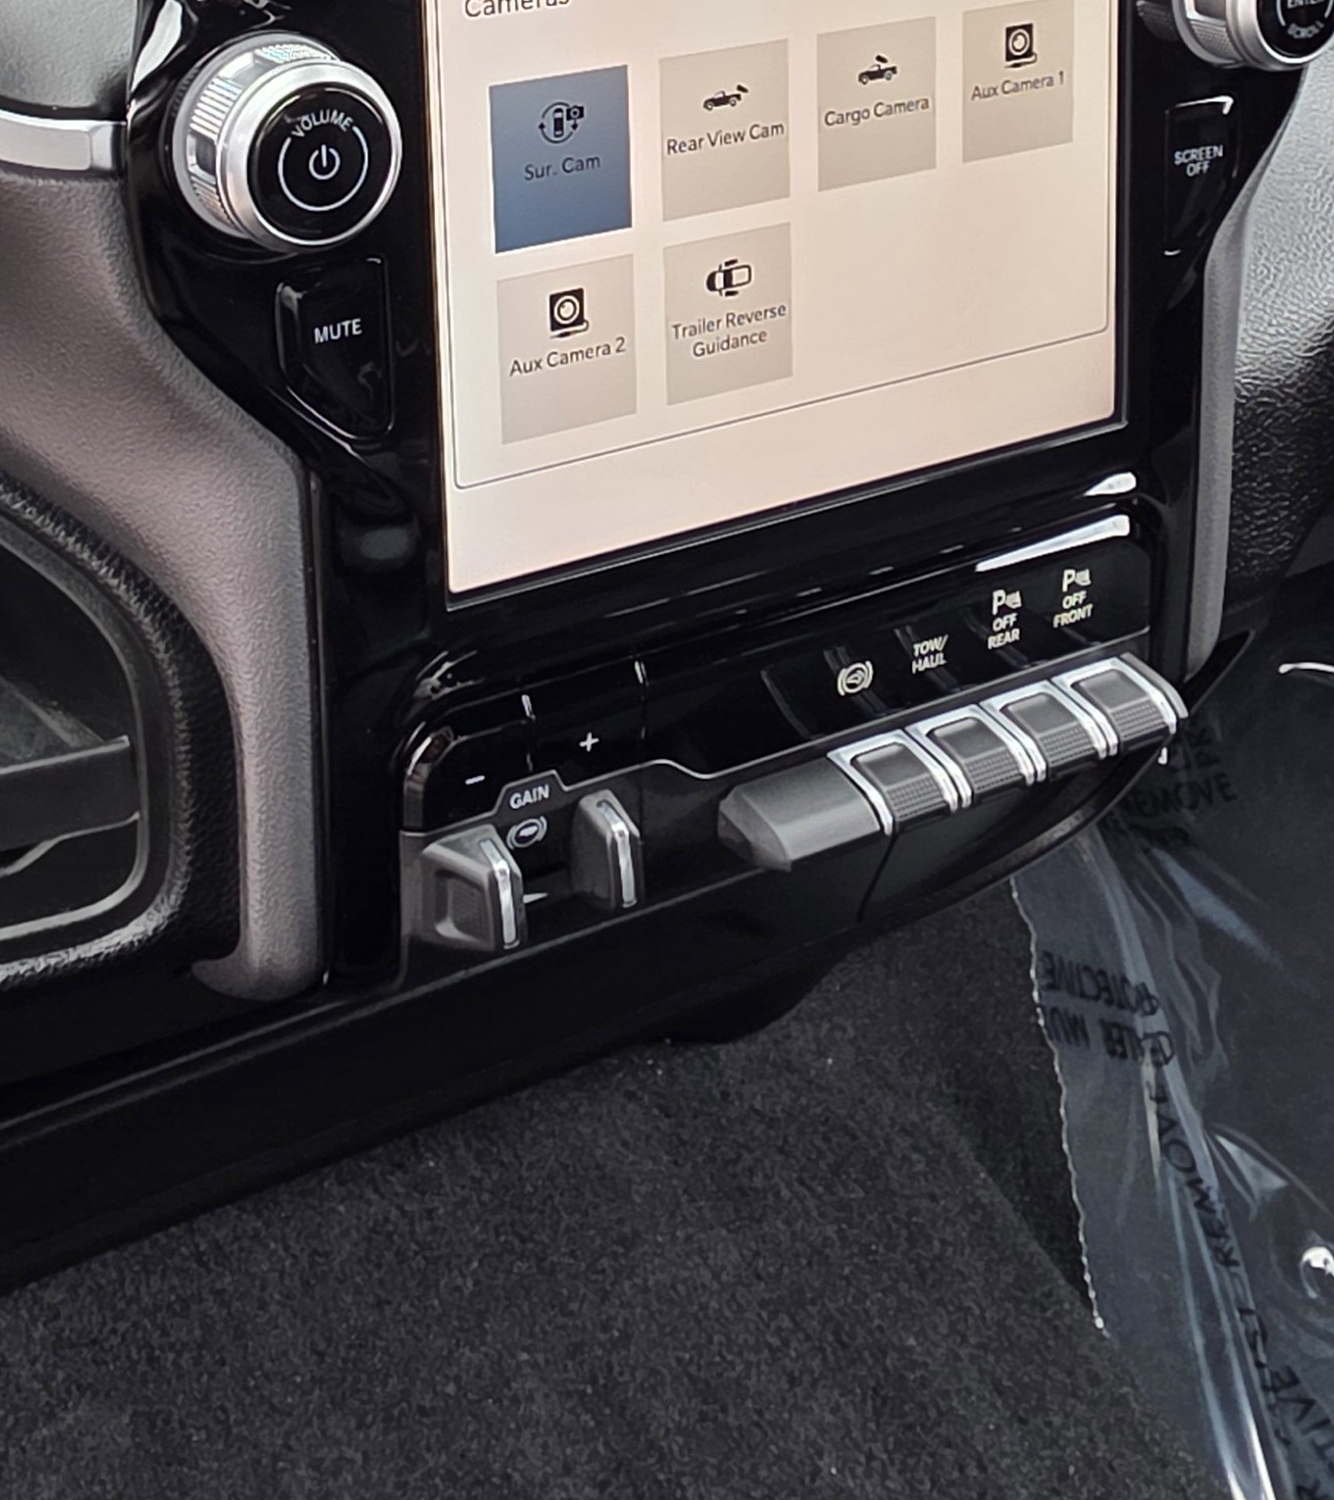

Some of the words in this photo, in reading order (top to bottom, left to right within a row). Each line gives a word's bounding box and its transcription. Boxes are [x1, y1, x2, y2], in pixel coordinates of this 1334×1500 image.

[970, 86, 999, 102] Aux
[1001, 75, 1054, 95] Camera
[1057, 70, 1065, 86] 1
[291, 109, 354, 137] VOLUME
[823, 108, 870, 126] Cargo
[873, 97, 930, 118] Camera
[667, 138, 704, 155] Rear
[707, 129, 746, 147] View
[749, 123, 784, 140] Cam
[1173, 145, 1224, 165] SCREEN
[524, 163, 558, 181] Sur.
[562, 156, 601, 174] Cam
[1186, 160, 1211, 177] OFF
[313, 318, 363, 344] MUTE
[672, 318, 722, 340] Trailer
[724, 304, 787, 329] Reverse
[692, 330, 768, 358] Guidance
[509, 359, 543, 378] Aux
[546, 343, 611, 368] Camera
[614, 336, 626, 353] 2
[1062, 590, 1087, 610] OFF
[992, 612, 1019, 632] OFF
[1053, 603, 1094, 629] FRONT
[913, 634, 949, 657] TOW/
[988, 628, 1021, 650] REAR
[911, 652, 948, 674] HAUL
[509, 784, 551, 809] GAIN
